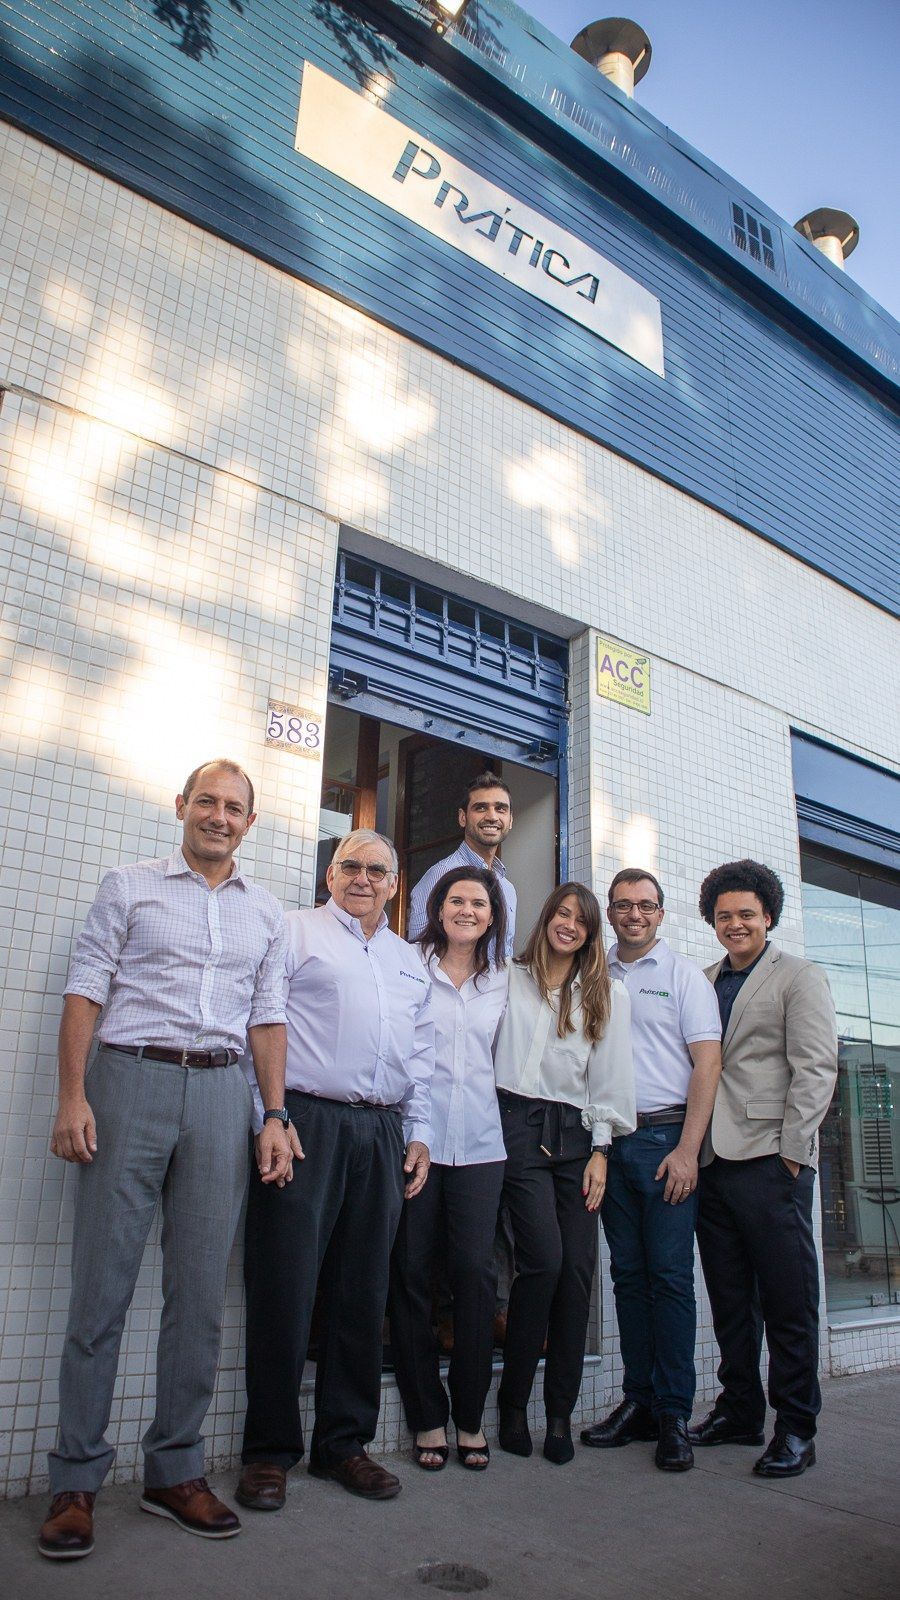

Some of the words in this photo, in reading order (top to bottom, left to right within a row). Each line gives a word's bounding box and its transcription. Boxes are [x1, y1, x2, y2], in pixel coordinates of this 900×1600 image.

[392, 140, 600, 304] PRÁTICA
[600, 654, 643, 688] ACC
[268, 711, 320, 748] 583
